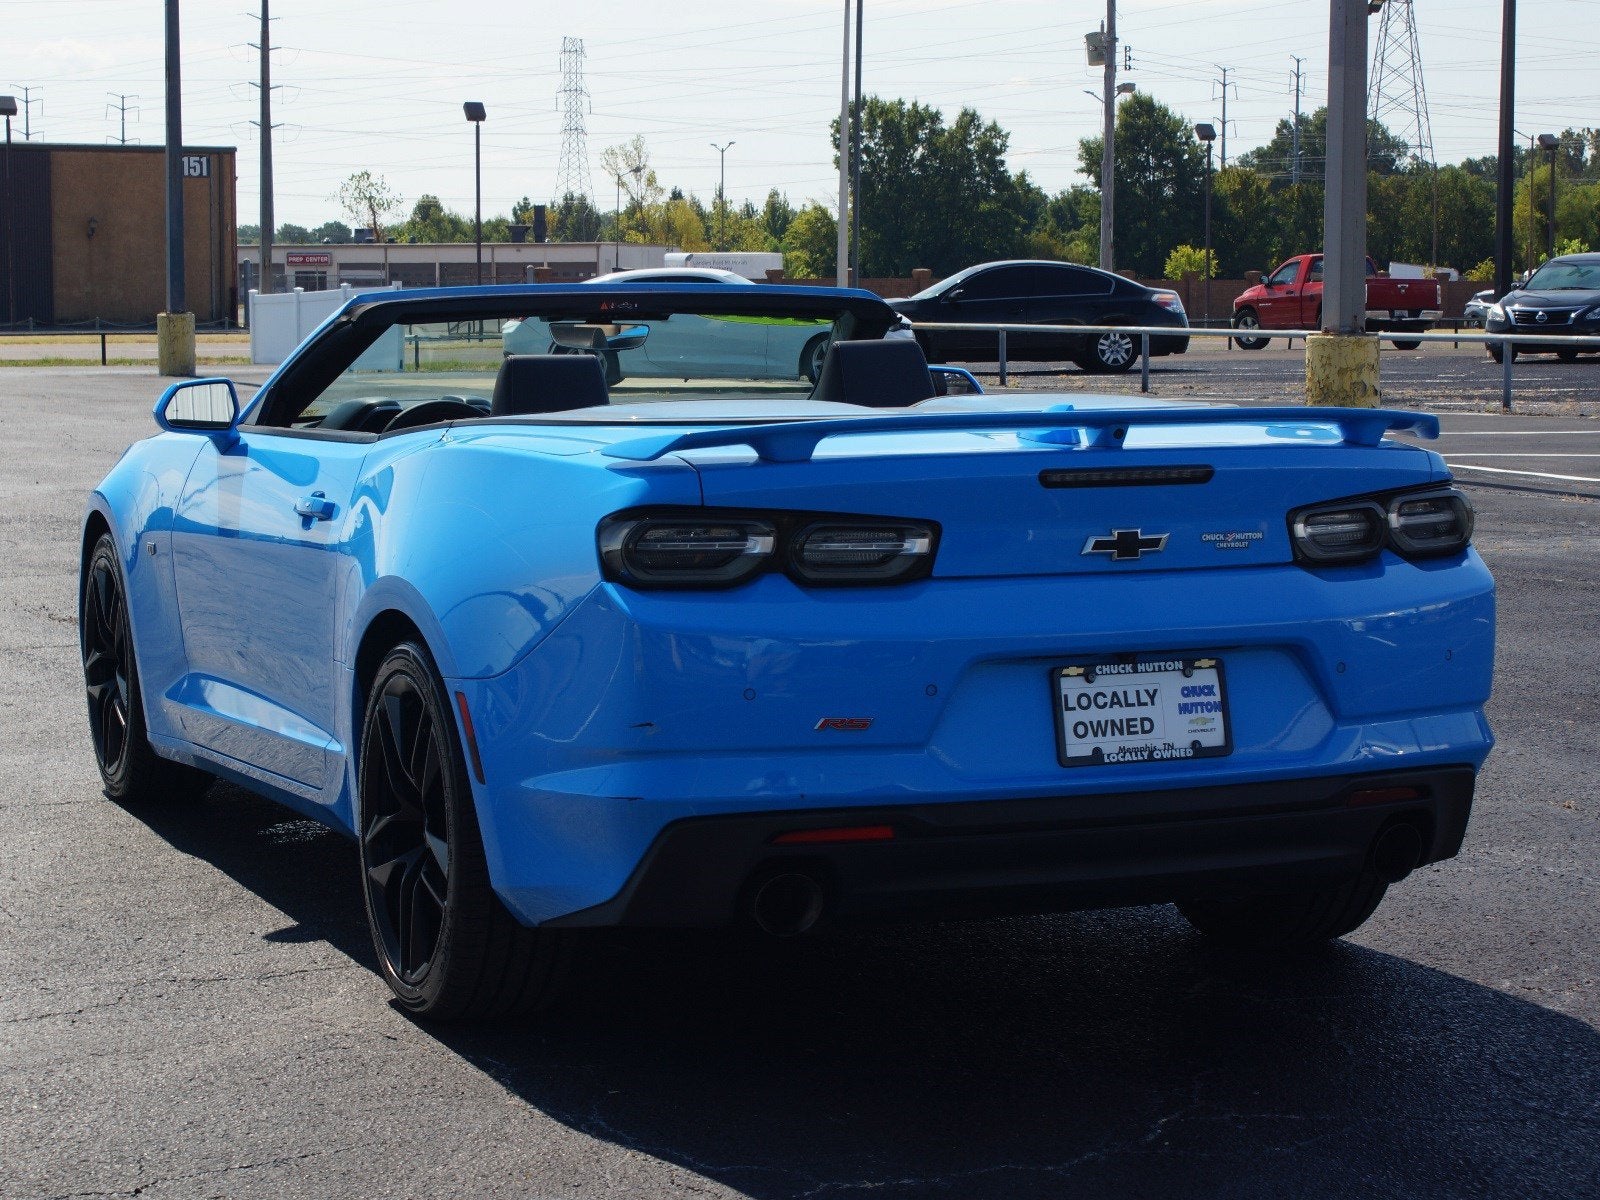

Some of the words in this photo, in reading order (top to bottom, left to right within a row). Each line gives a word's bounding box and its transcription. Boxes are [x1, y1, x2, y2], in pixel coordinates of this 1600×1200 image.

[182, 156, 207, 177] 151
[1201, 533, 1225, 541] CHUCK
[1235, 532, 1263, 540] HUTTON
[1095, 664, 1134, 675] CHUCK
[1137, 660, 1184, 673] HUTTON
[1180, 684, 1217, 698] CHUCK
[1063, 688, 1159, 712] LOCALLY
[1177, 700, 1223, 714] HUTTON
[813, 717, 874, 730] RS
[1072, 716, 1155, 739] OWNED
[1162, 742, 1175, 751] TN
[1103, 752, 1149, 763] LOCALLY
[1153, 748, 1194, 759] OWNED
